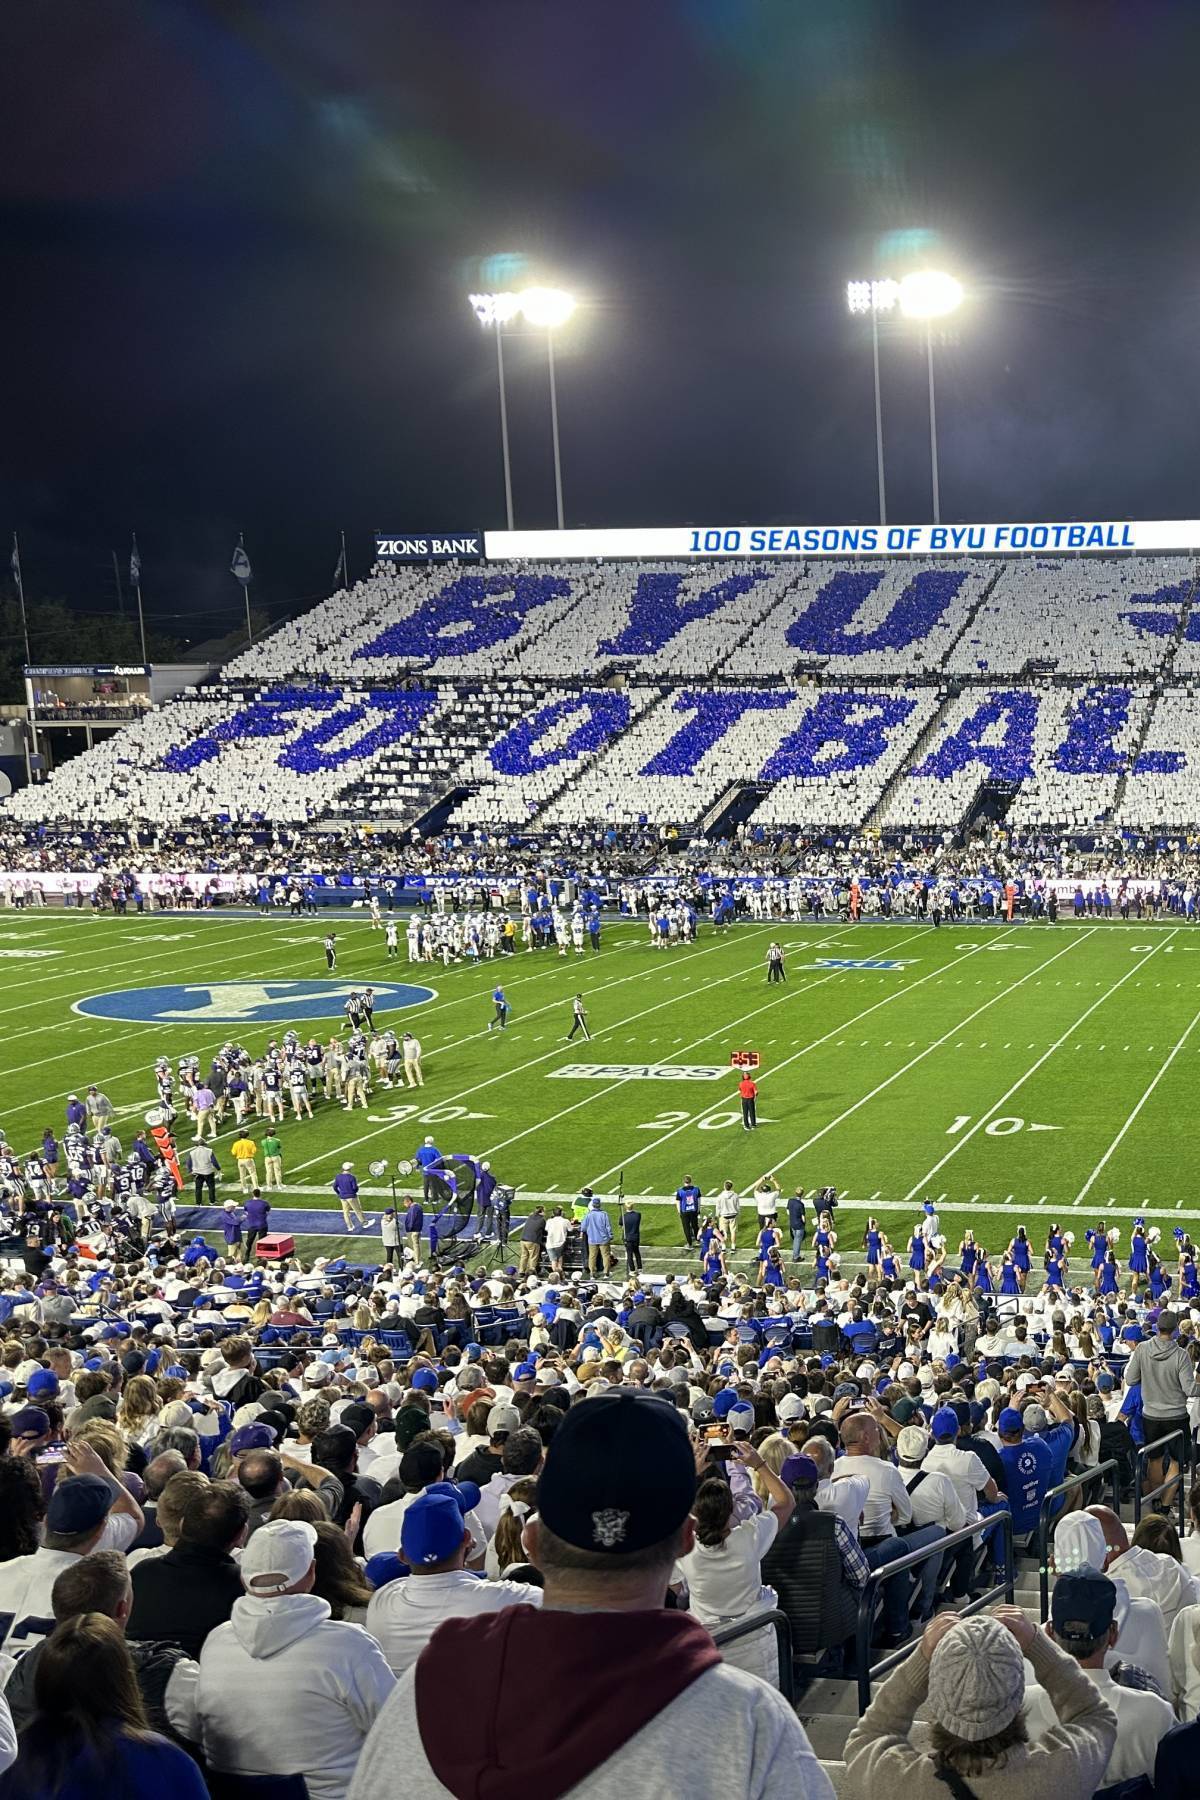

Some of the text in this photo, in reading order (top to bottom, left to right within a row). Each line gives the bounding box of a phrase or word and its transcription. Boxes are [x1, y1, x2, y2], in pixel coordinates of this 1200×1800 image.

[376, 539, 479, 555] ZIONS BANK
[690, 524, 1136, 552] 100 SEASONS OF BYU FOOTBALL
[352, 567, 970, 657] BYU
[732, 1052, 760, 1067] 2:53
[590, 1066, 720, 1078] PACS
[367, 1104, 468, 1124] 30
[636, 1111, 743, 1130] 20
[945, 1115, 1025, 1136] 10
